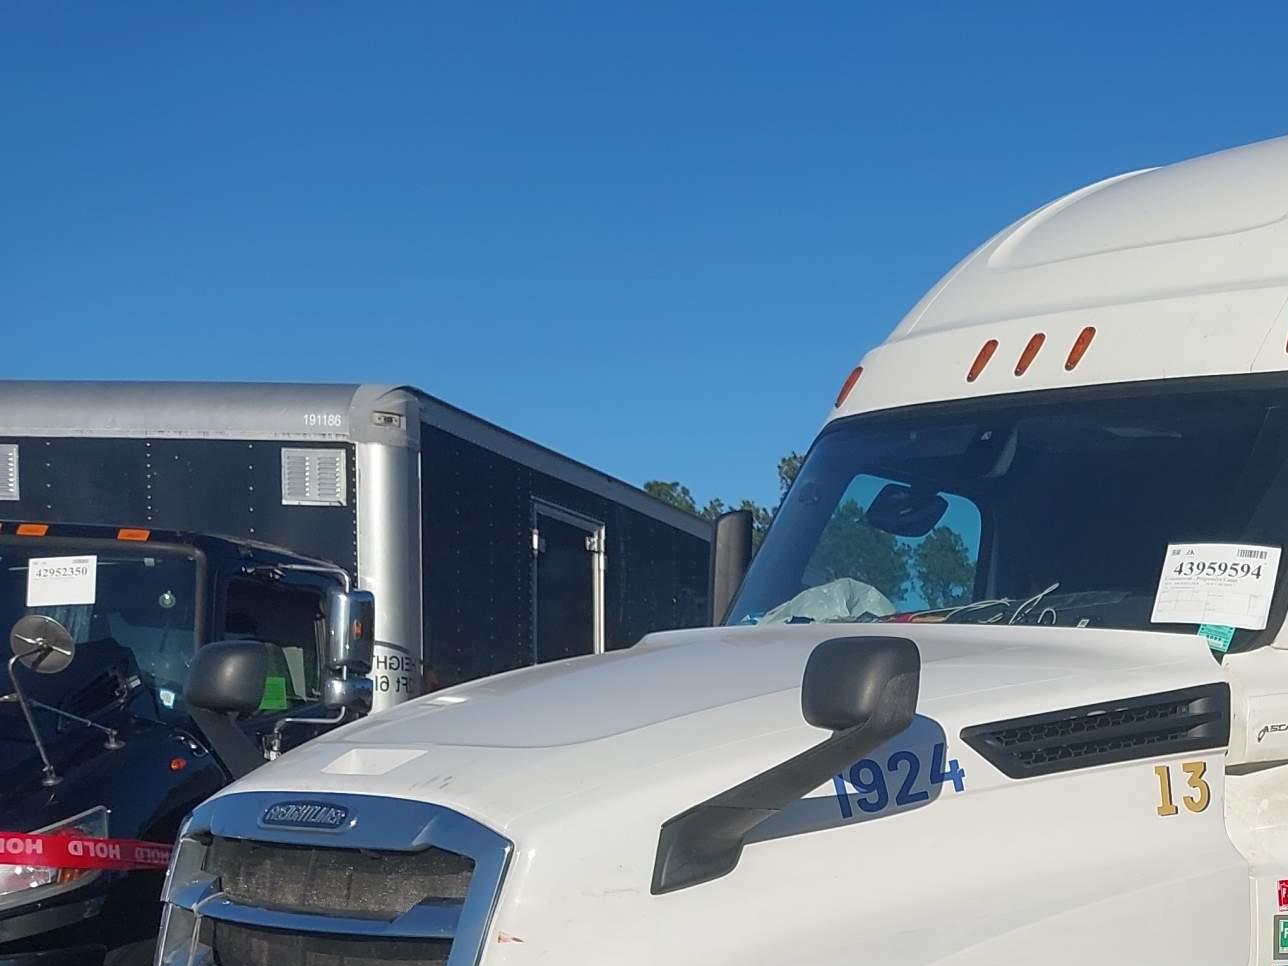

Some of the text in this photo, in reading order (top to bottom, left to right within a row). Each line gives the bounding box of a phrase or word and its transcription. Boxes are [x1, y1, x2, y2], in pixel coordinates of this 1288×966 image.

[303, 413, 342, 426] 191186
[35, 566, 88, 577] 42952350
[1174, 561, 1263, 580] 43959594
[832, 742, 965, 819] 1924
[1154, 761, 1211, 816] 13
[67, 840, 121, 859] HOLD
